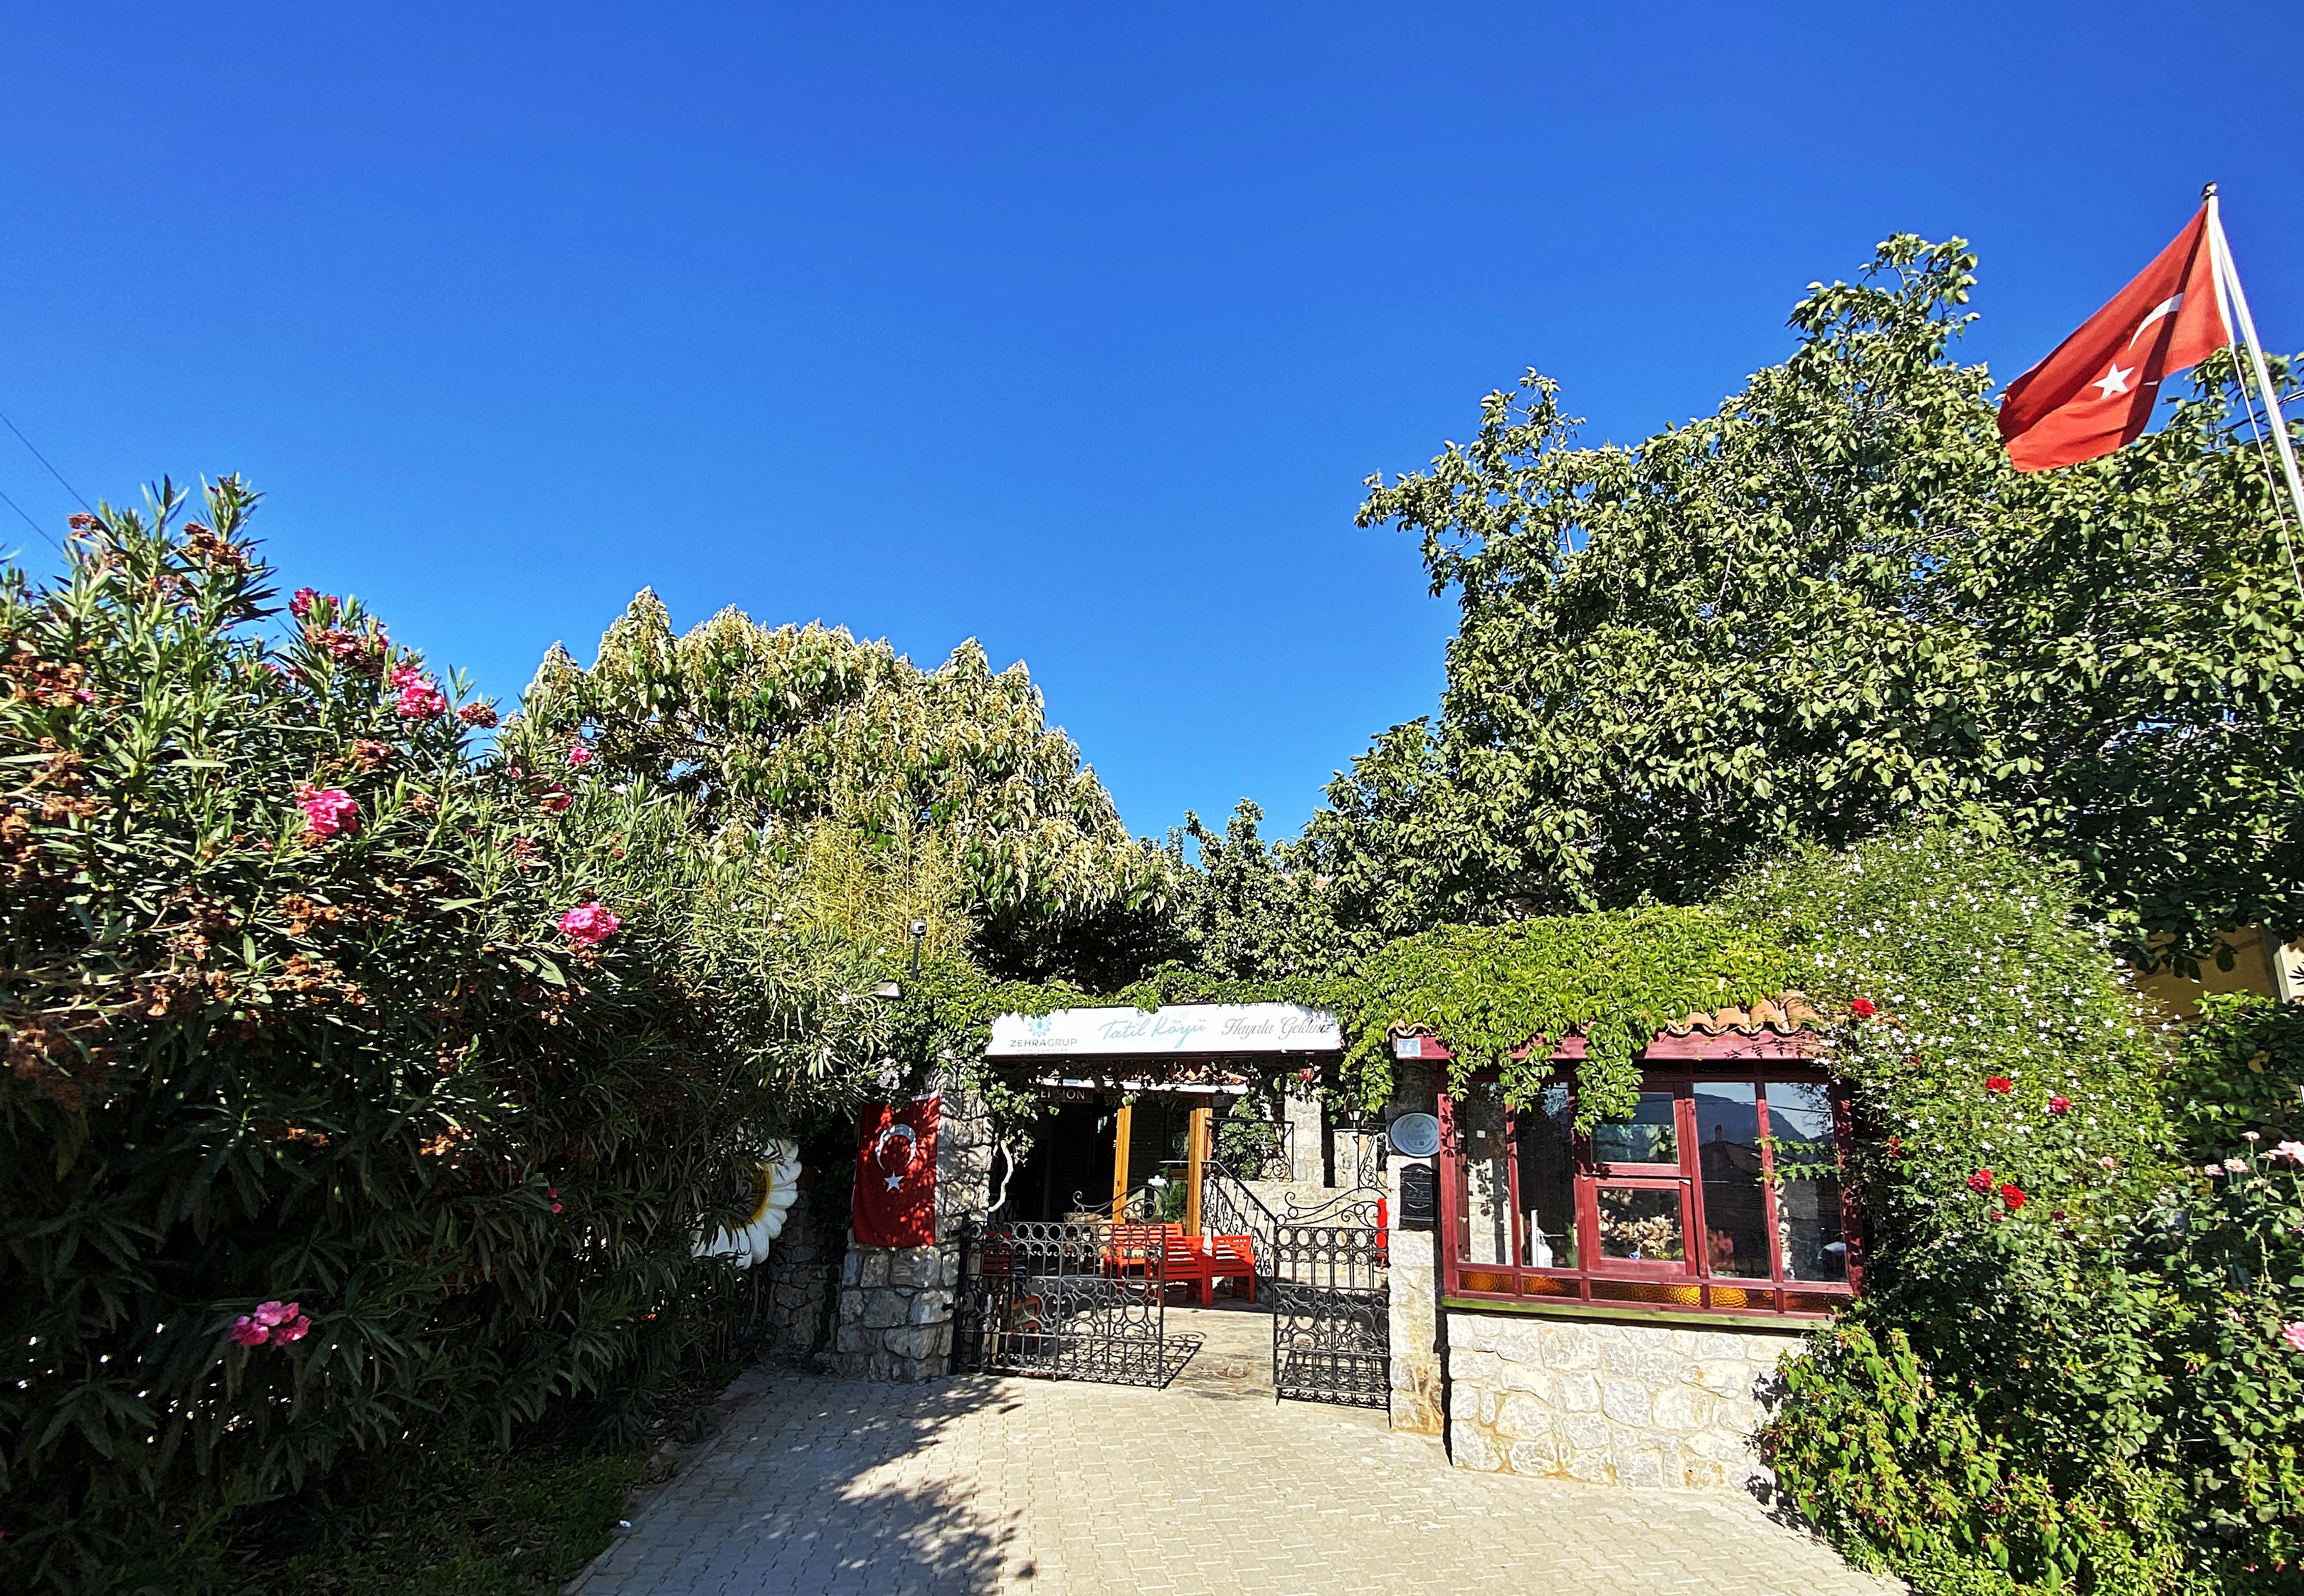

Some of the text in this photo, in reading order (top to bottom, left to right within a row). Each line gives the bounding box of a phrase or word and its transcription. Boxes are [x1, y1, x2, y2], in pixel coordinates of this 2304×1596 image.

[1098, 1015, 1206, 1049] Tatil Köyü
[1222, 1016, 1334, 1040] Hayırla Geldiniz
[1010, 1038, 1077, 1047] ZEHRAGRUP
